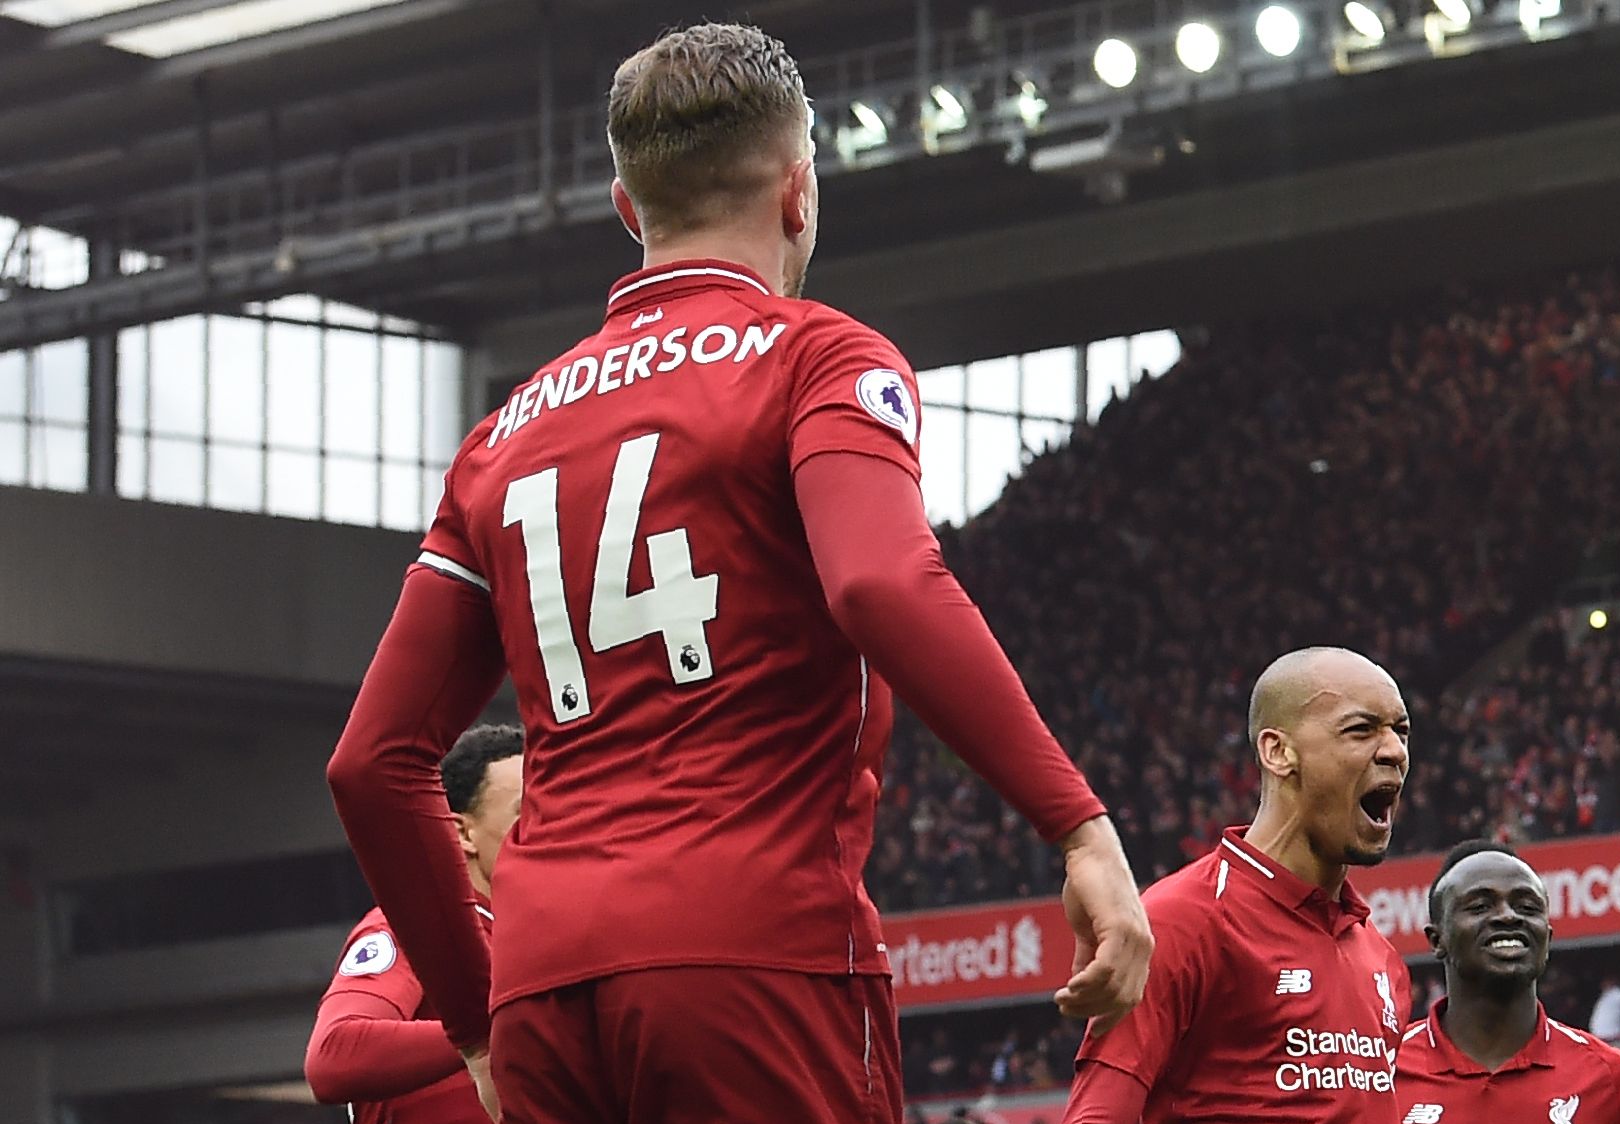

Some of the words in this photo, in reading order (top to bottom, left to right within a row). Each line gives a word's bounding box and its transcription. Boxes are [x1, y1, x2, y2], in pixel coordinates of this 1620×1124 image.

[486, 323, 787, 449] HENDERSON
[502, 432, 719, 724] 14
[1285, 1027, 1391, 1059] Standar
